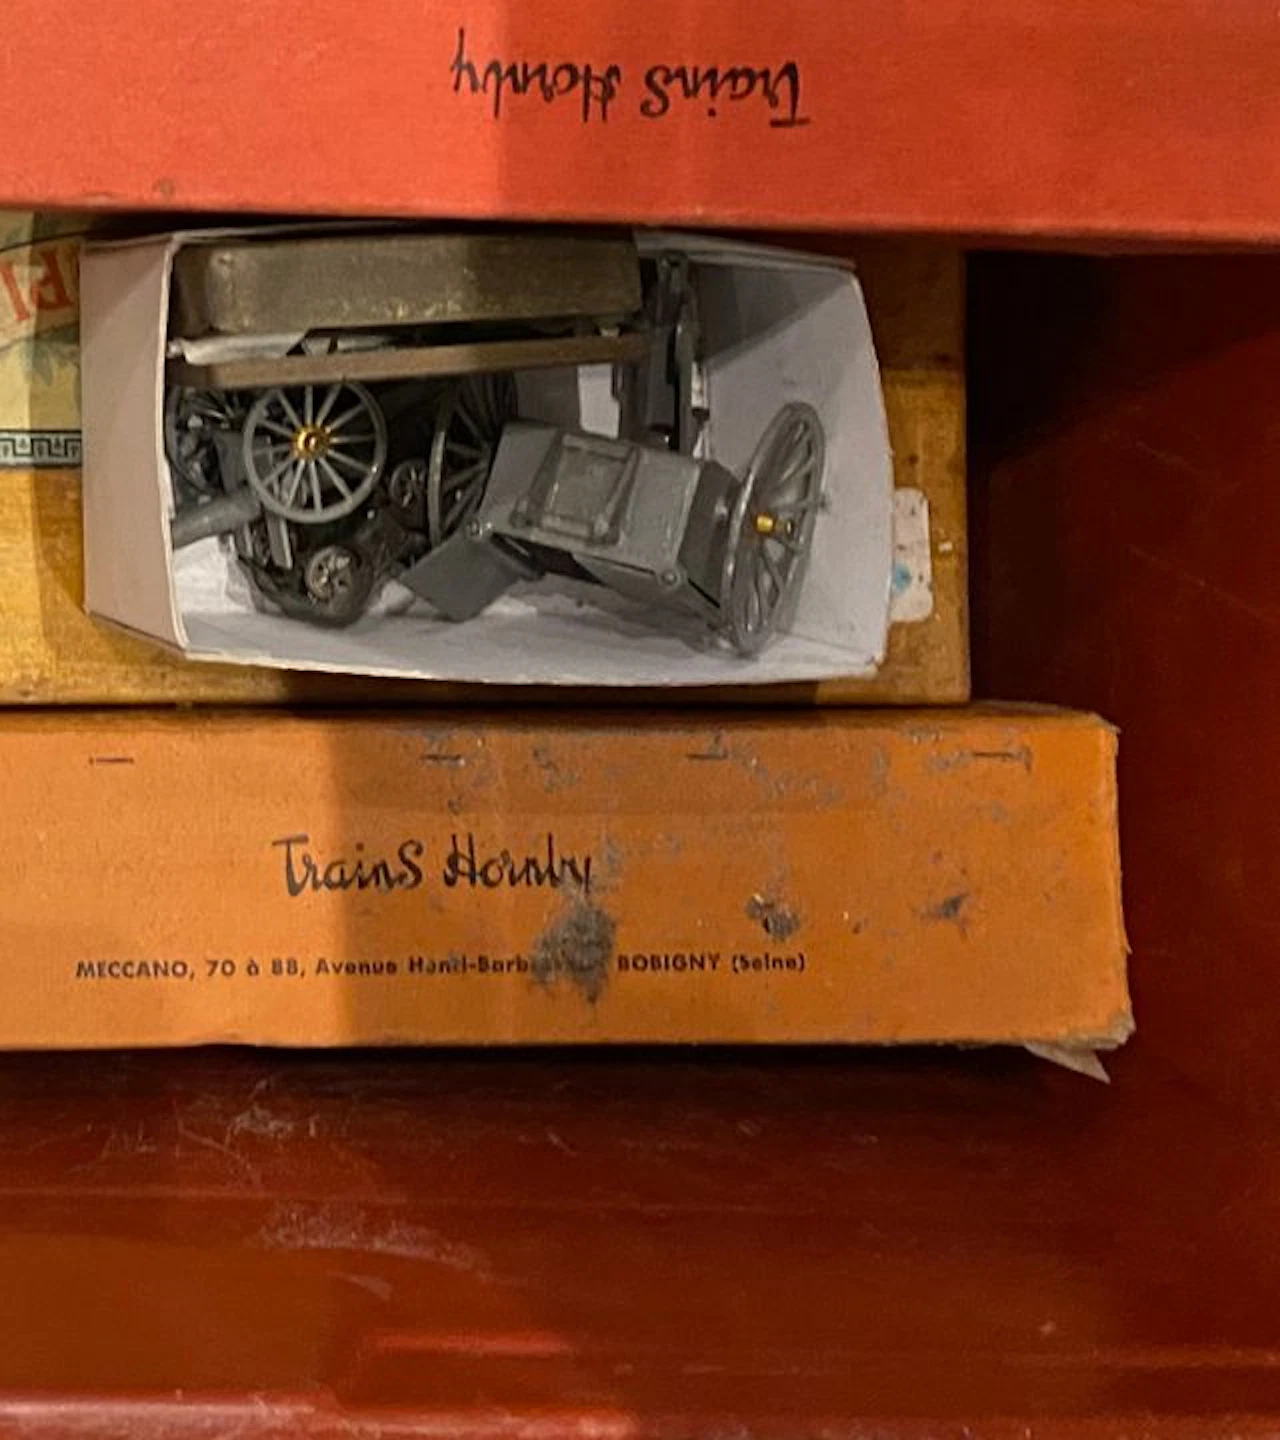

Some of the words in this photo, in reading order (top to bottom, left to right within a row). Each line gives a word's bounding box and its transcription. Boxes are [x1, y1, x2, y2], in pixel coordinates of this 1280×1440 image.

[449, 26, 622, 123] Hornby
[442, 831, 592, 895] Hornby
[75, 960, 196, 982] MECCANO,
[205, 958, 236, 978] 70
[270, 958, 306, 979] 88,
[315, 958, 398, 977] Avenue
[617, 952, 721, 973] BOBIGNY
[731, 951, 806, 975] (Seine)
